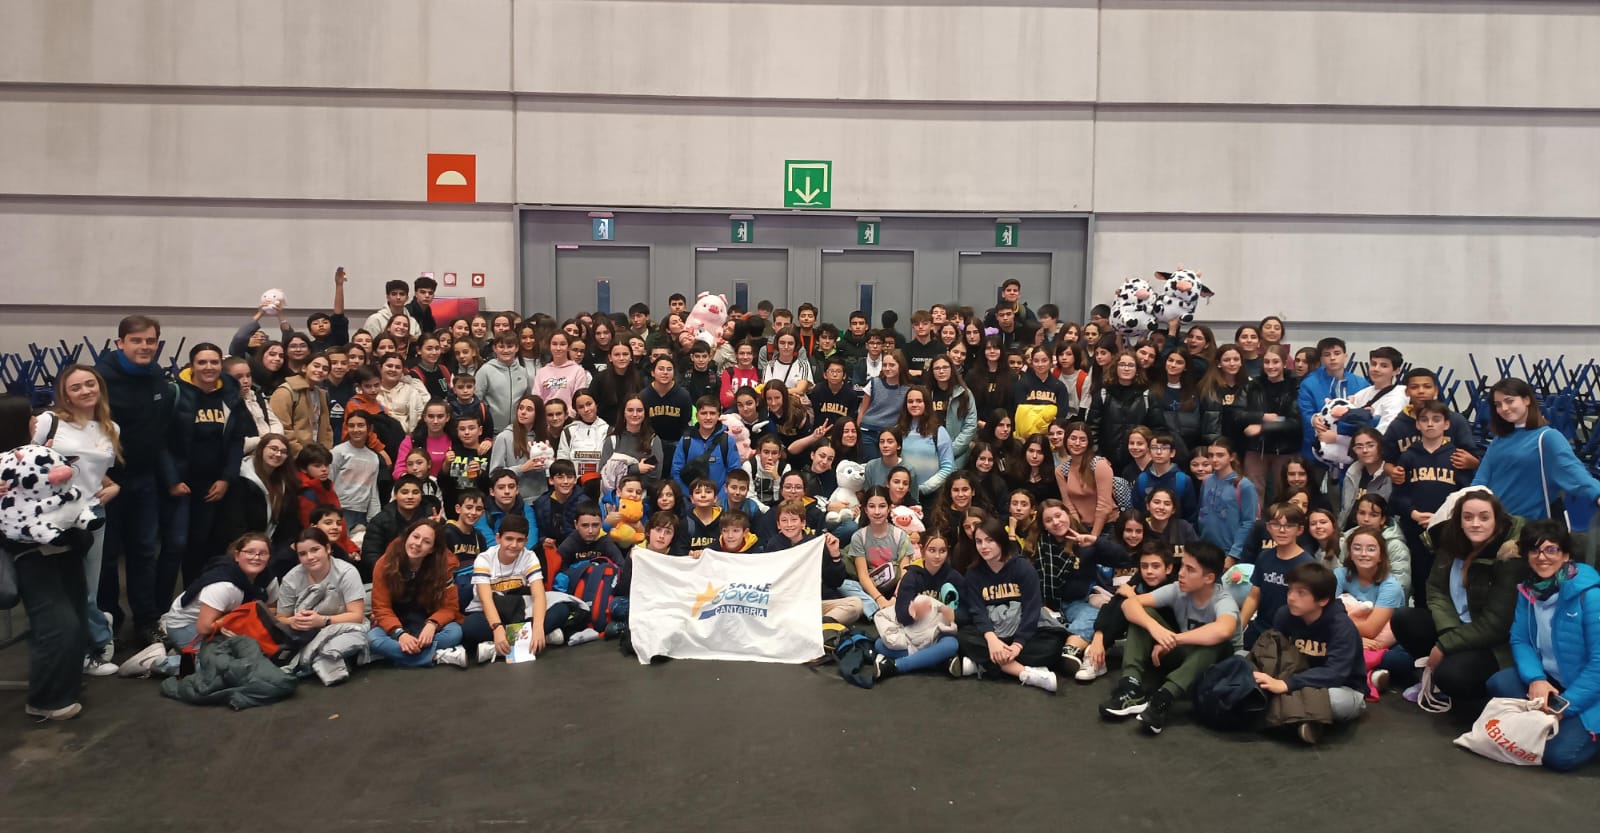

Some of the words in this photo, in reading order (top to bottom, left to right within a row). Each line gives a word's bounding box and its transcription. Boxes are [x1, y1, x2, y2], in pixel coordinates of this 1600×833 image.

[649, 405, 681, 417] ASALLE
[715, 605, 764, 617] CANTABRIA
[1486, 727, 1537, 763] Bizkaia
